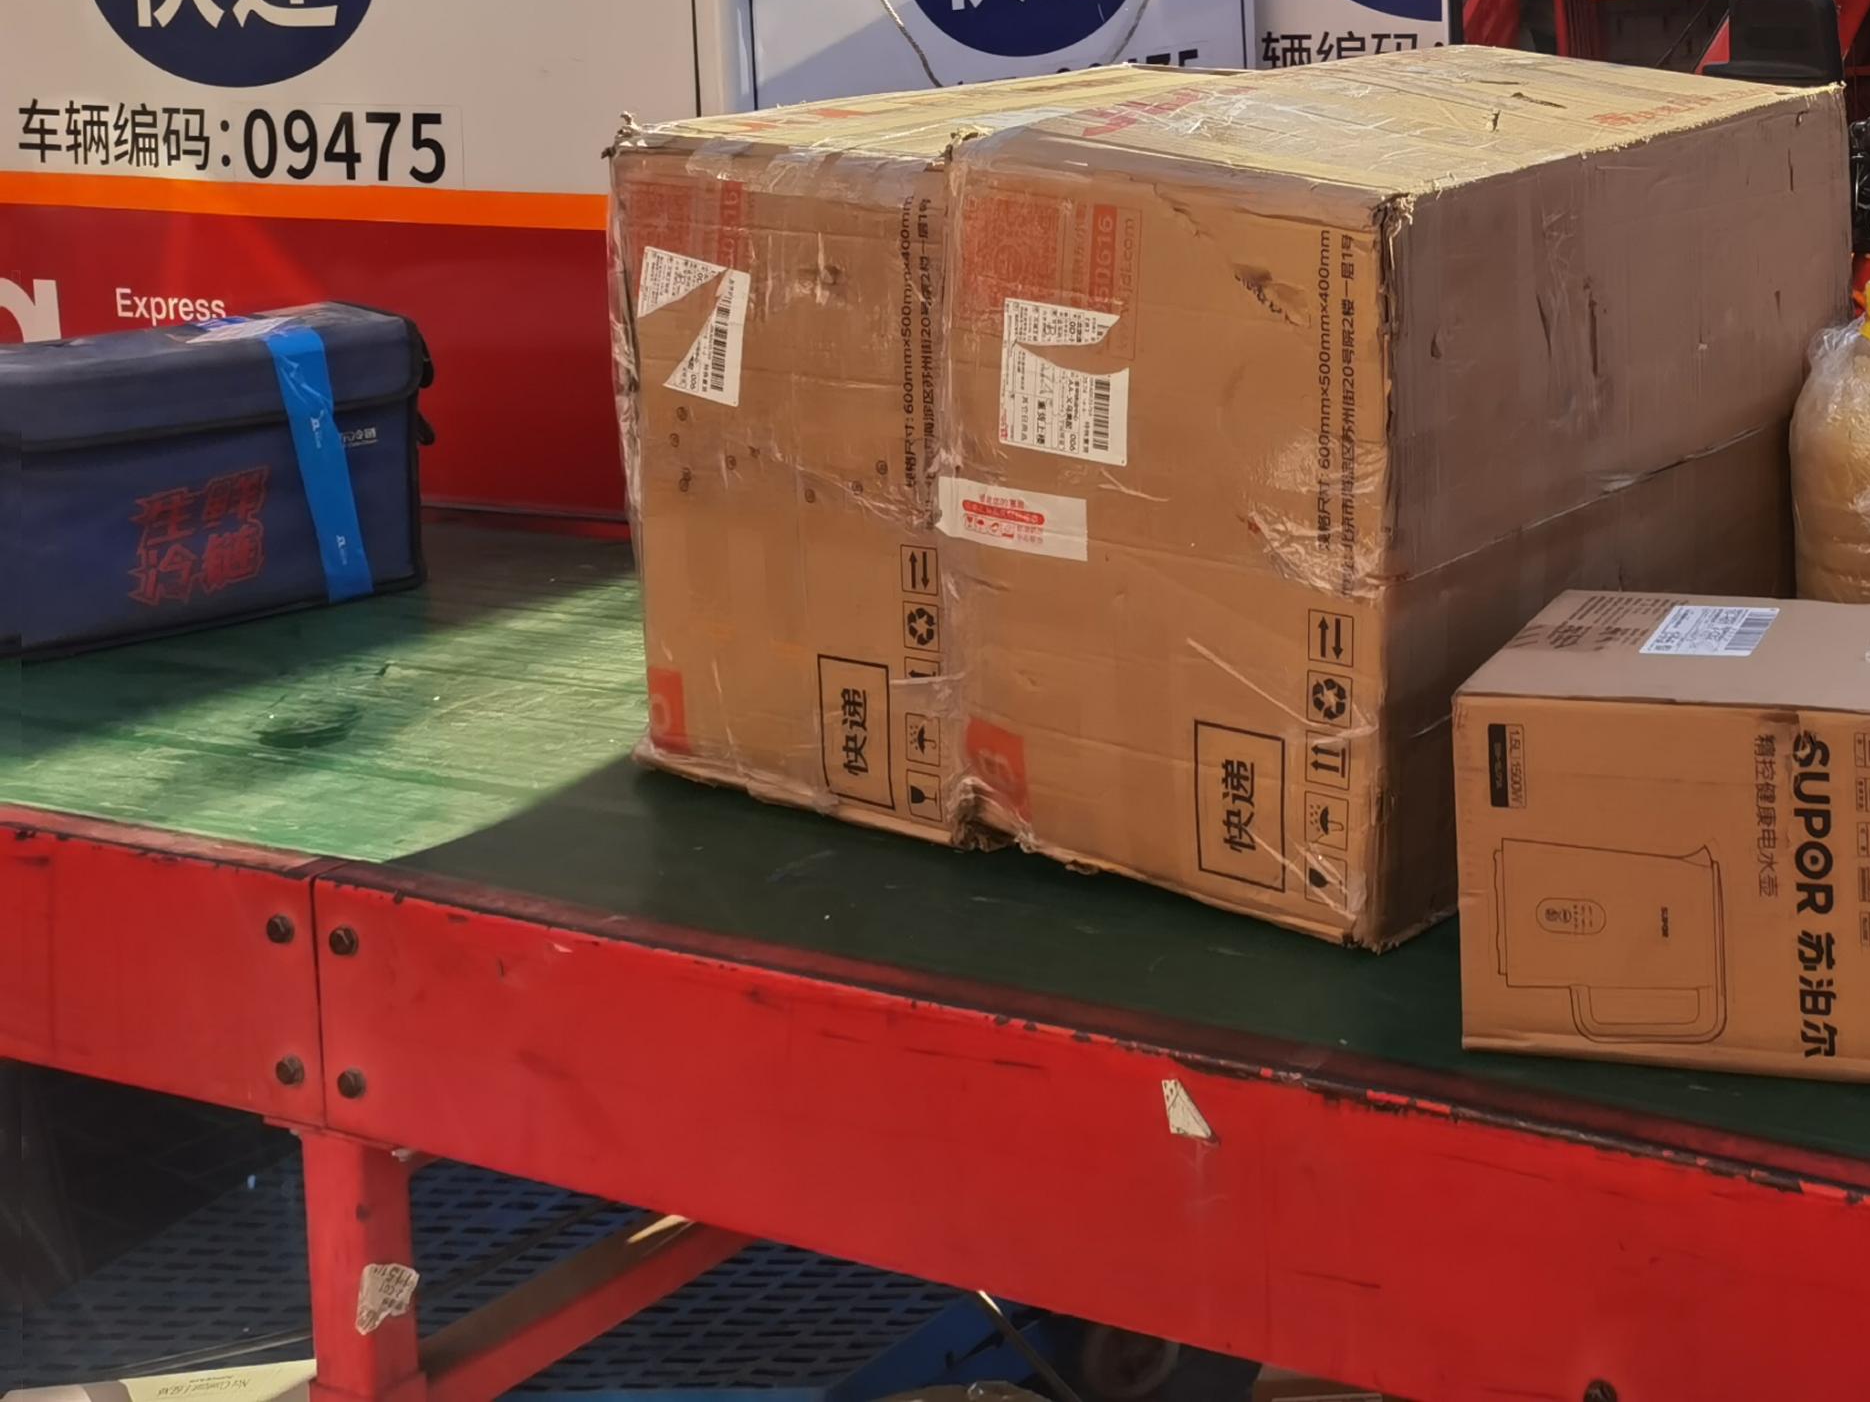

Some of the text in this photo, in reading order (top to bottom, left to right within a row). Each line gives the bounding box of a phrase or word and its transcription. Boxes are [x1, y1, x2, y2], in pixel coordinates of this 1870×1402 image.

[114, 286, 227, 327] Express
[1068, 432, 1078, 452] 006
[844, 686, 868, 778] 快递
[1222, 757, 1256, 854] 快递
[1792, 728, 1838, 1059] SUPOR 苏泊尔
